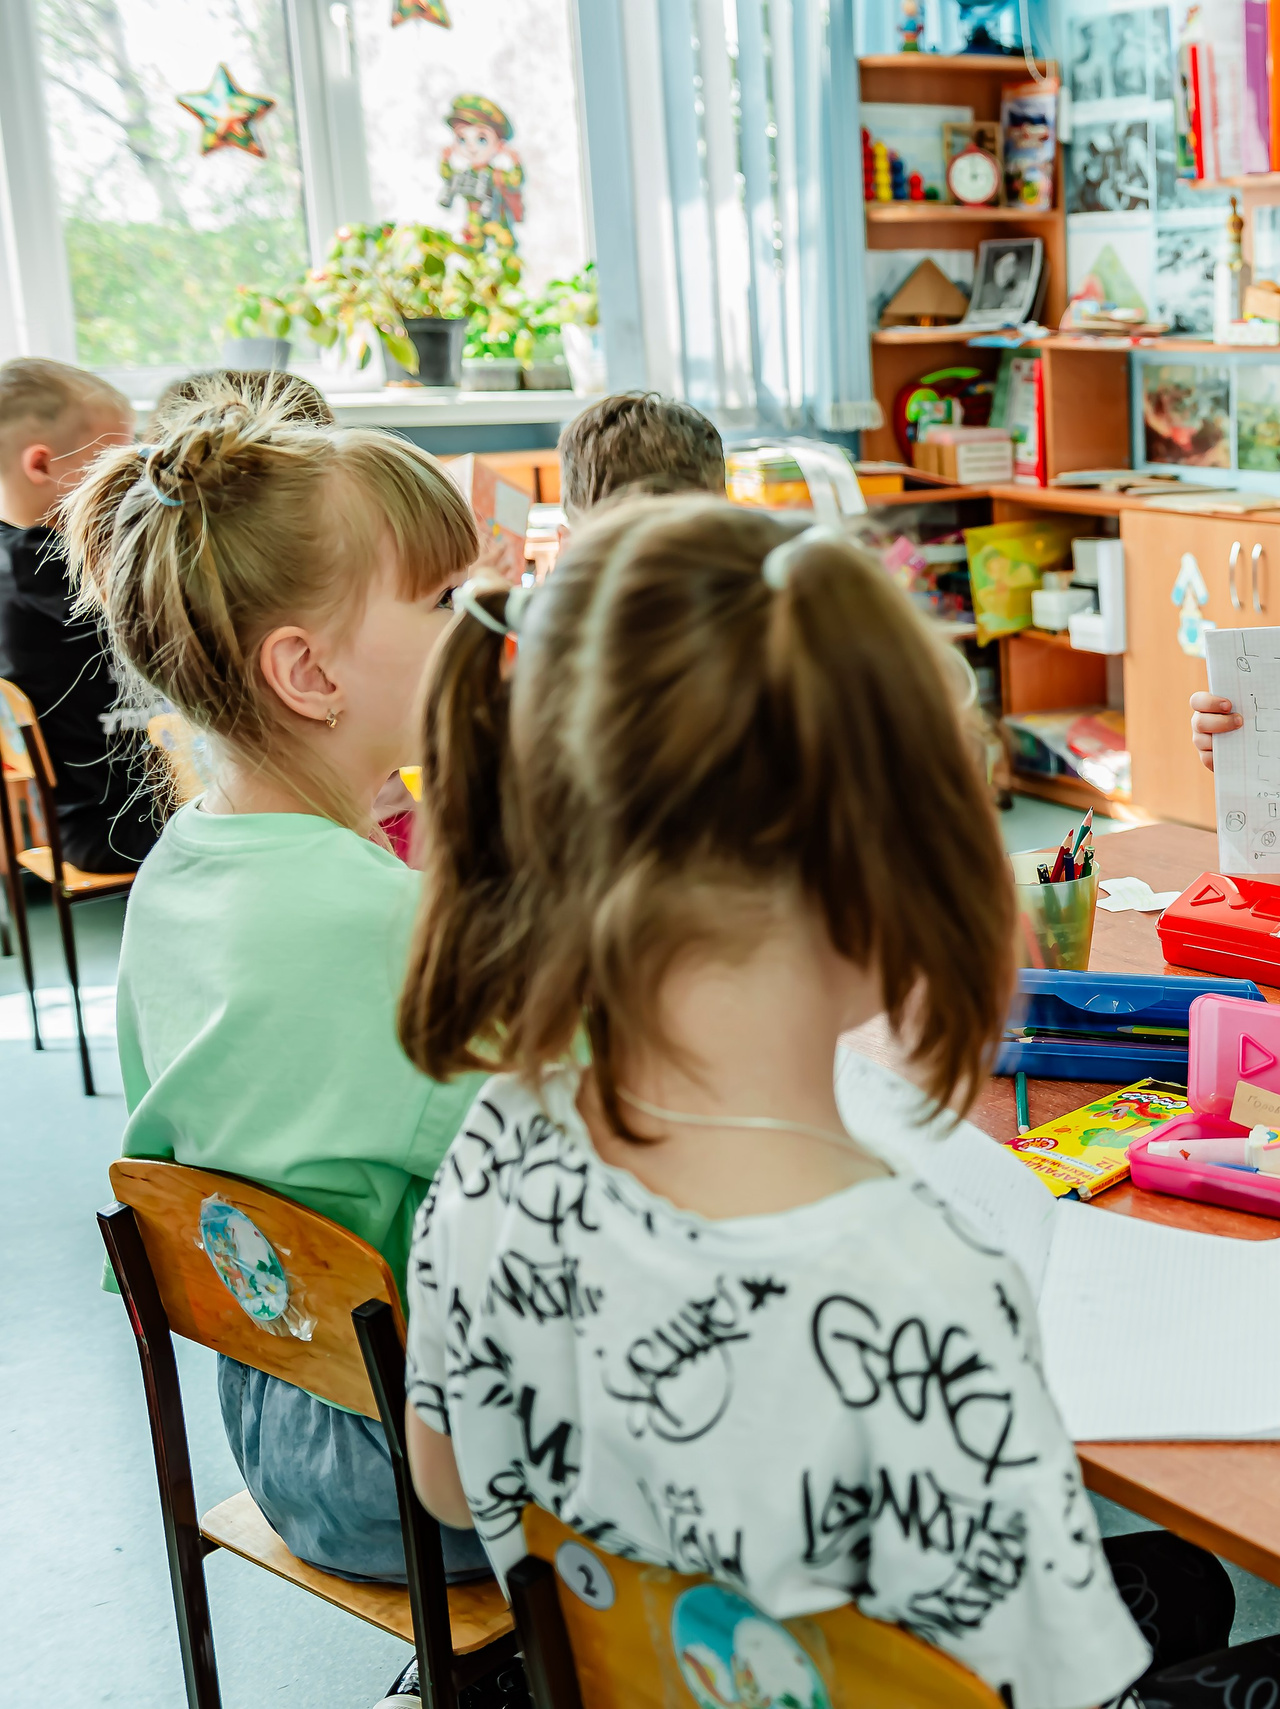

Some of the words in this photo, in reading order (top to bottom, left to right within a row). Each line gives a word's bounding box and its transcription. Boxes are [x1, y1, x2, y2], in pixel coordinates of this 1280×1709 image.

[1019, 1159, 1086, 1185] КАРАНД
[1096, 1160, 1115, 1171] 12
[577, 1563, 599, 1599] 2
